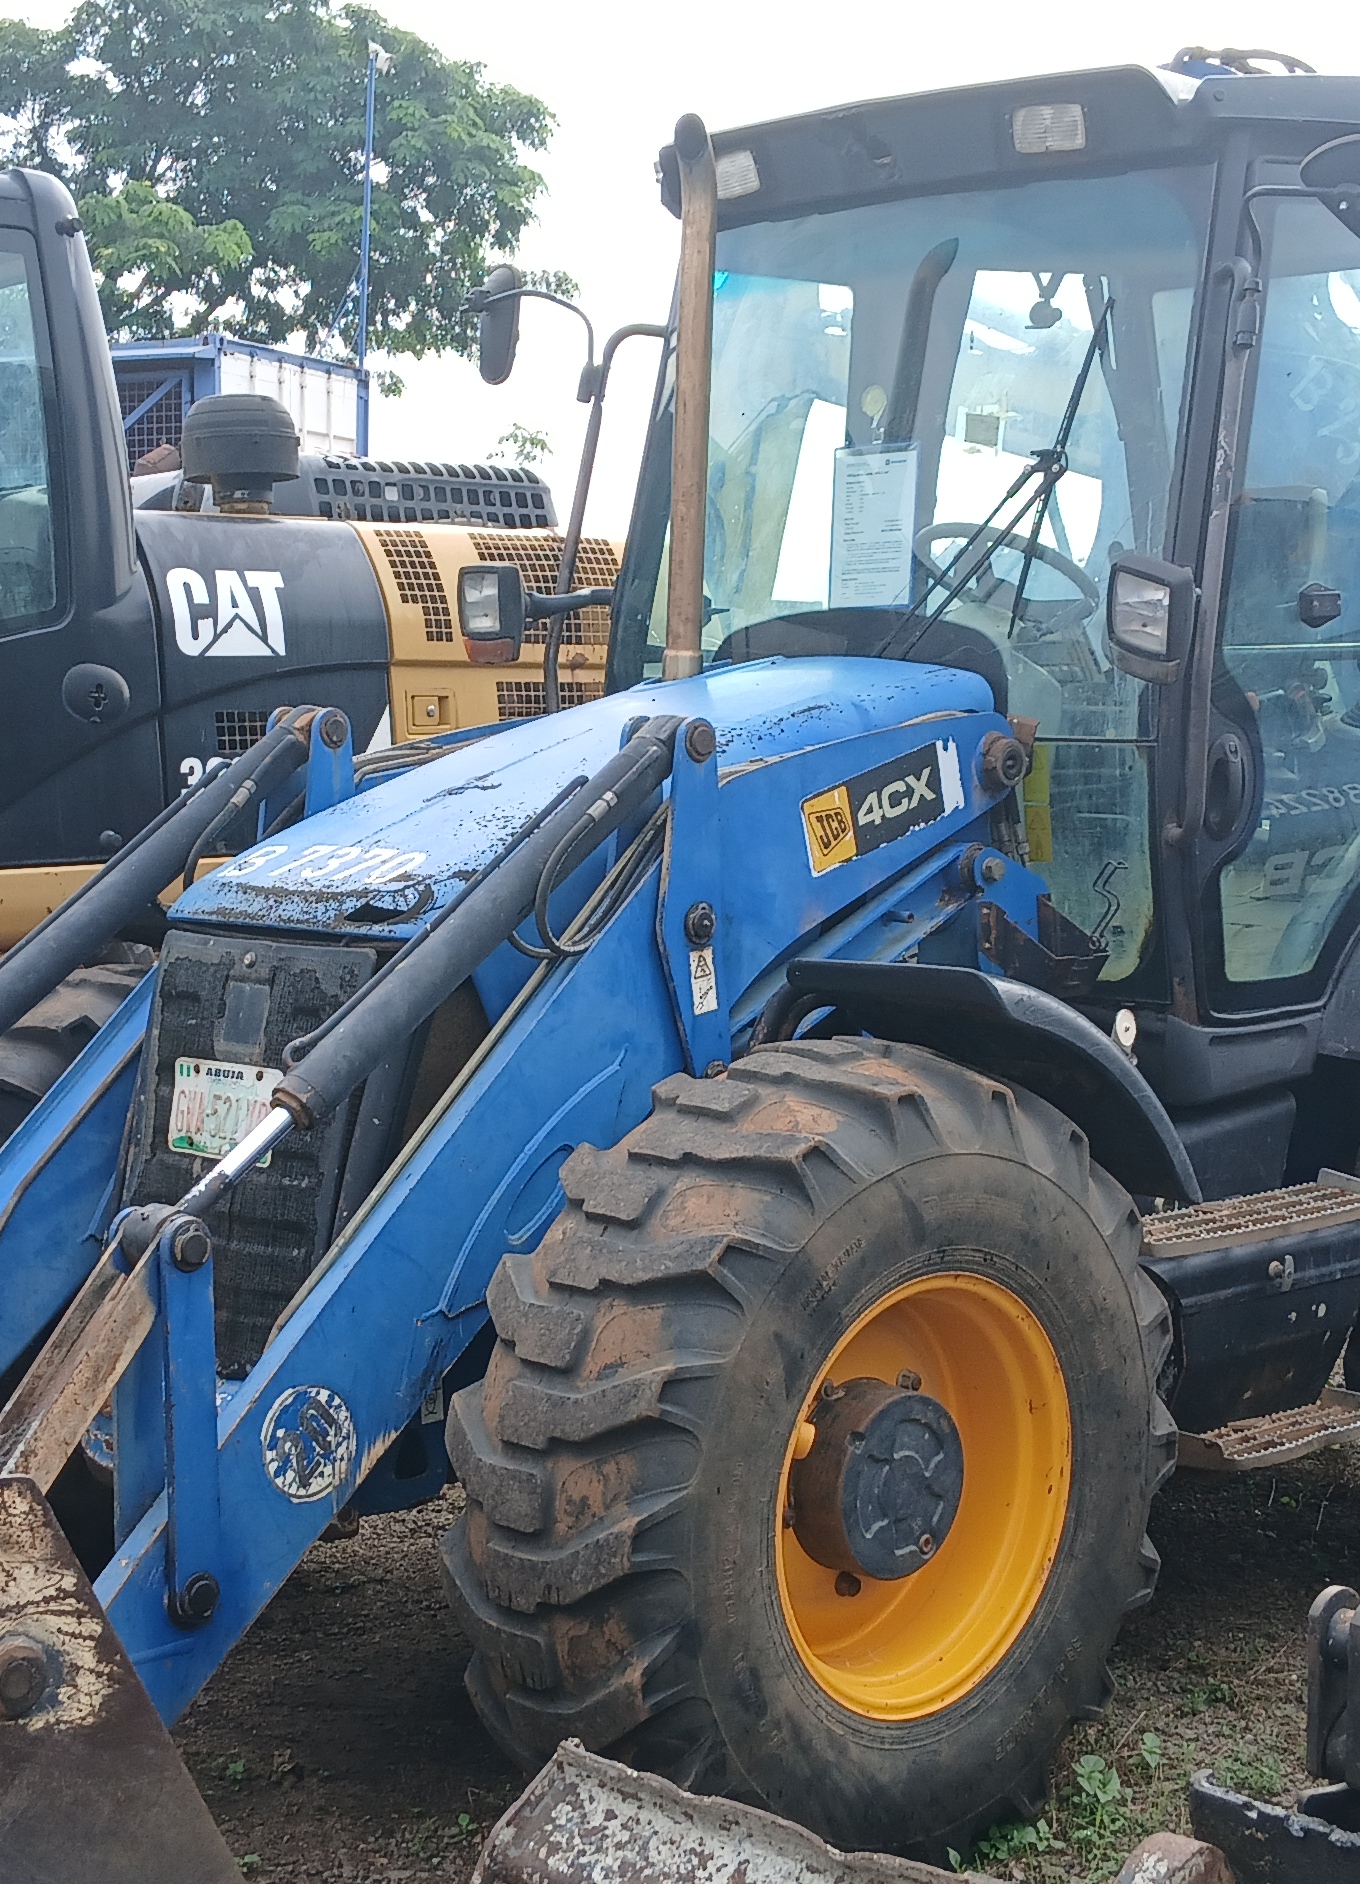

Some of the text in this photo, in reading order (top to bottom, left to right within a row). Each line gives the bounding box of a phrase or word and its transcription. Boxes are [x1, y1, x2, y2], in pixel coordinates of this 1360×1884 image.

[166, 567, 286, 657] CAT
[857, 766, 937, 827] 4CX
[815, 811, 847, 850] JCB
[205, 1067, 245, 1082] ABUJA
